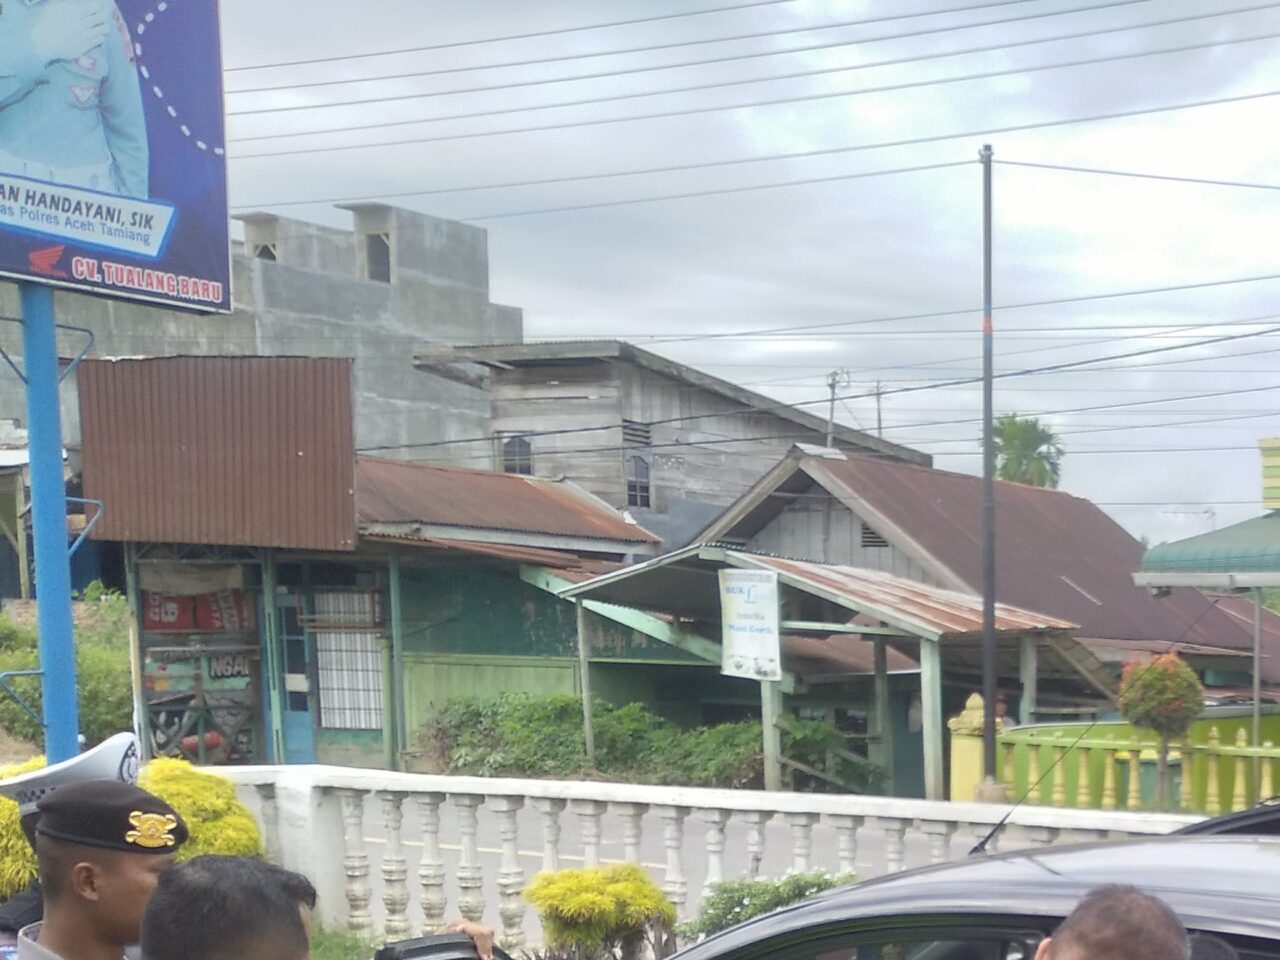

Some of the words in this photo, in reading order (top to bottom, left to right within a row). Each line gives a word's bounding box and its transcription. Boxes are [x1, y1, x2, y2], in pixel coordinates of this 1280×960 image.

[20, 206, 60, 226] Polres
[65, 216, 95, 233] Aceh
[100, 222, 151, 246] Tamiang
[25, 189, 125, 227] HANDAYANI,
[130, 212, 154, 230] SIK
[72, 256, 102, 282] CV.
[102, 261, 177, 296] TUALANG
[178, 276, 223, 303] BARU
